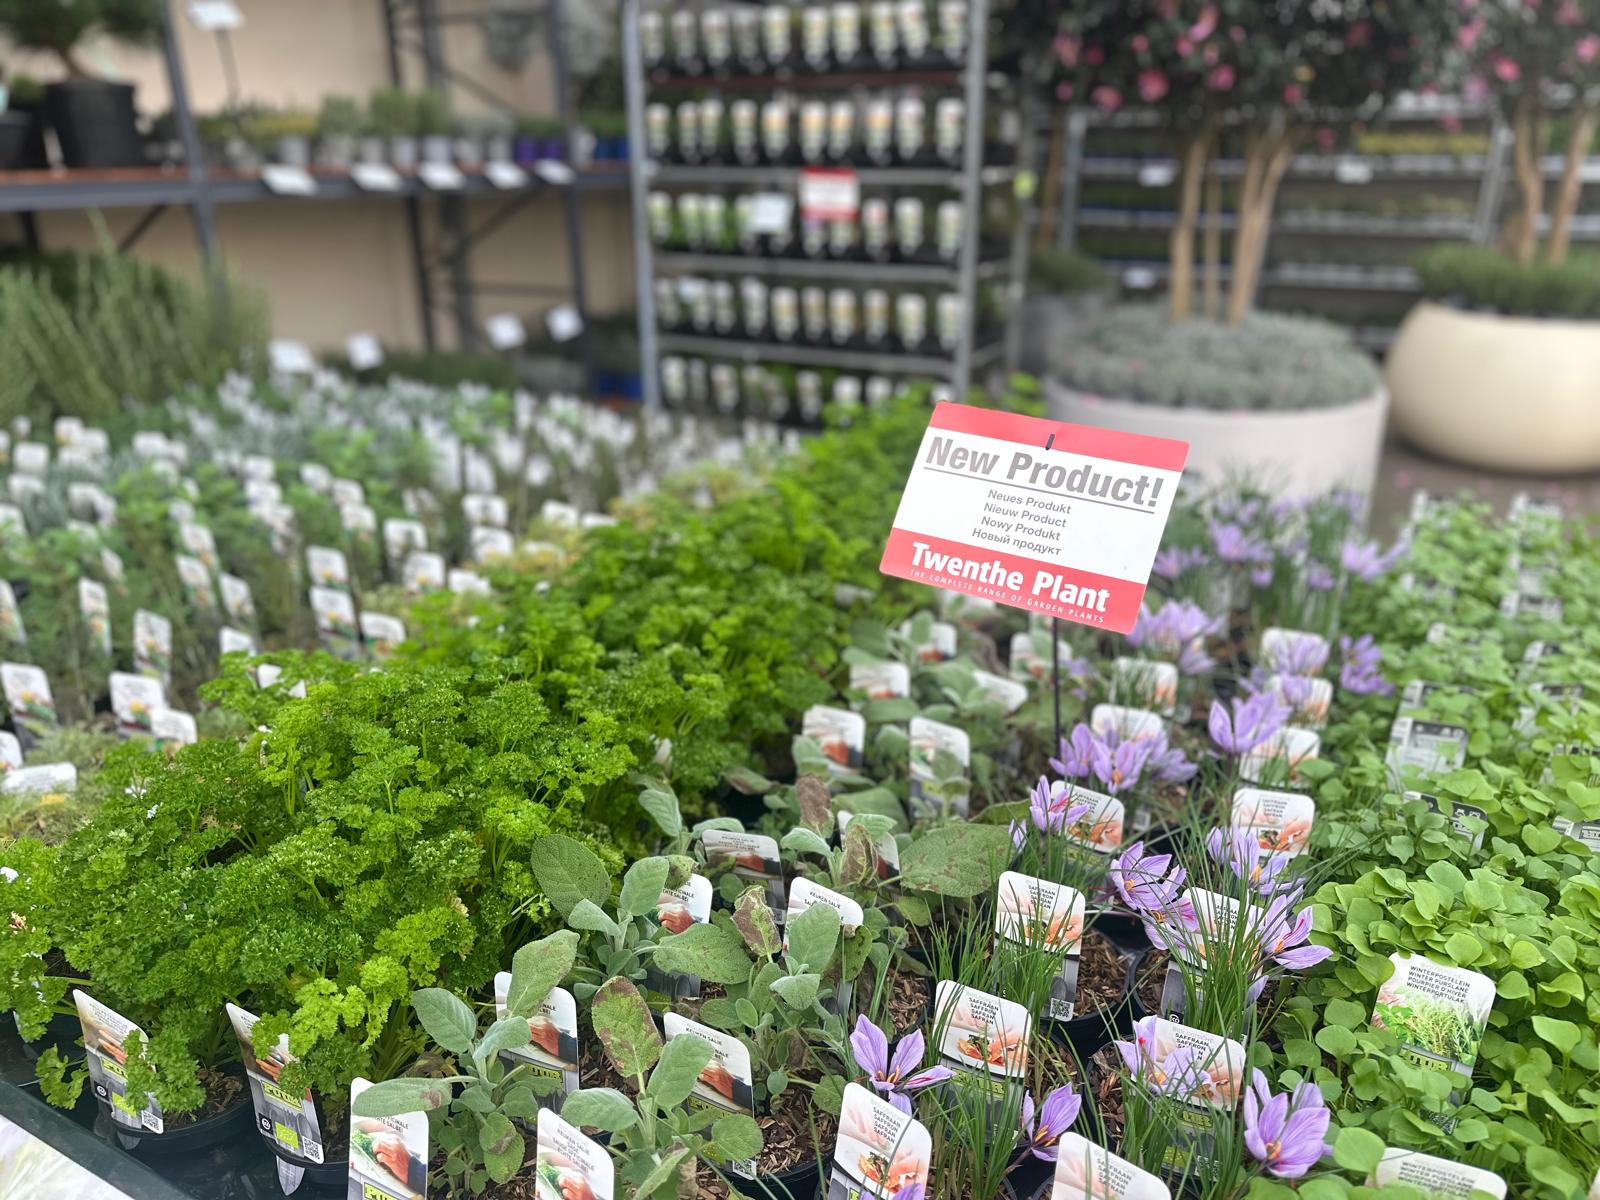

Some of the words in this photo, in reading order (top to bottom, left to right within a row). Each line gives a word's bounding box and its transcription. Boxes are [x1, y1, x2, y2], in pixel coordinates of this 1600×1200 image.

[925, 435, 1000, 476] New
[1006, 451, 1164, 507] Product!
[988, 489, 1022, 505] Neues
[1025, 497, 1072, 514] Produkt
[984, 502, 1019, 518] Nieuw
[1021, 510, 1067, 528] Product
[981, 516, 1013, 532] Nowy
[1015, 523, 1061, 541] Produkt
[972, 528, 1011, 545] Новый
[1012, 538, 1062, 556] продукт
[911, 541, 1024, 591] Twenthe
[1032, 570, 1110, 612] Plant
[910, 569, 925, 578] THE
[929, 574, 973, 590] COMPLETE
[977, 586, 1006, 599] RANGE
[1011, 594, 1023, 603] OF
[1027, 598, 1064, 613] GARDEN
[1069, 609, 1104, 623] PLANTS
[1408, 971, 1433, 983] WINTER
[1410, 965, 1470, 988] WINTERPOSTELEIN
